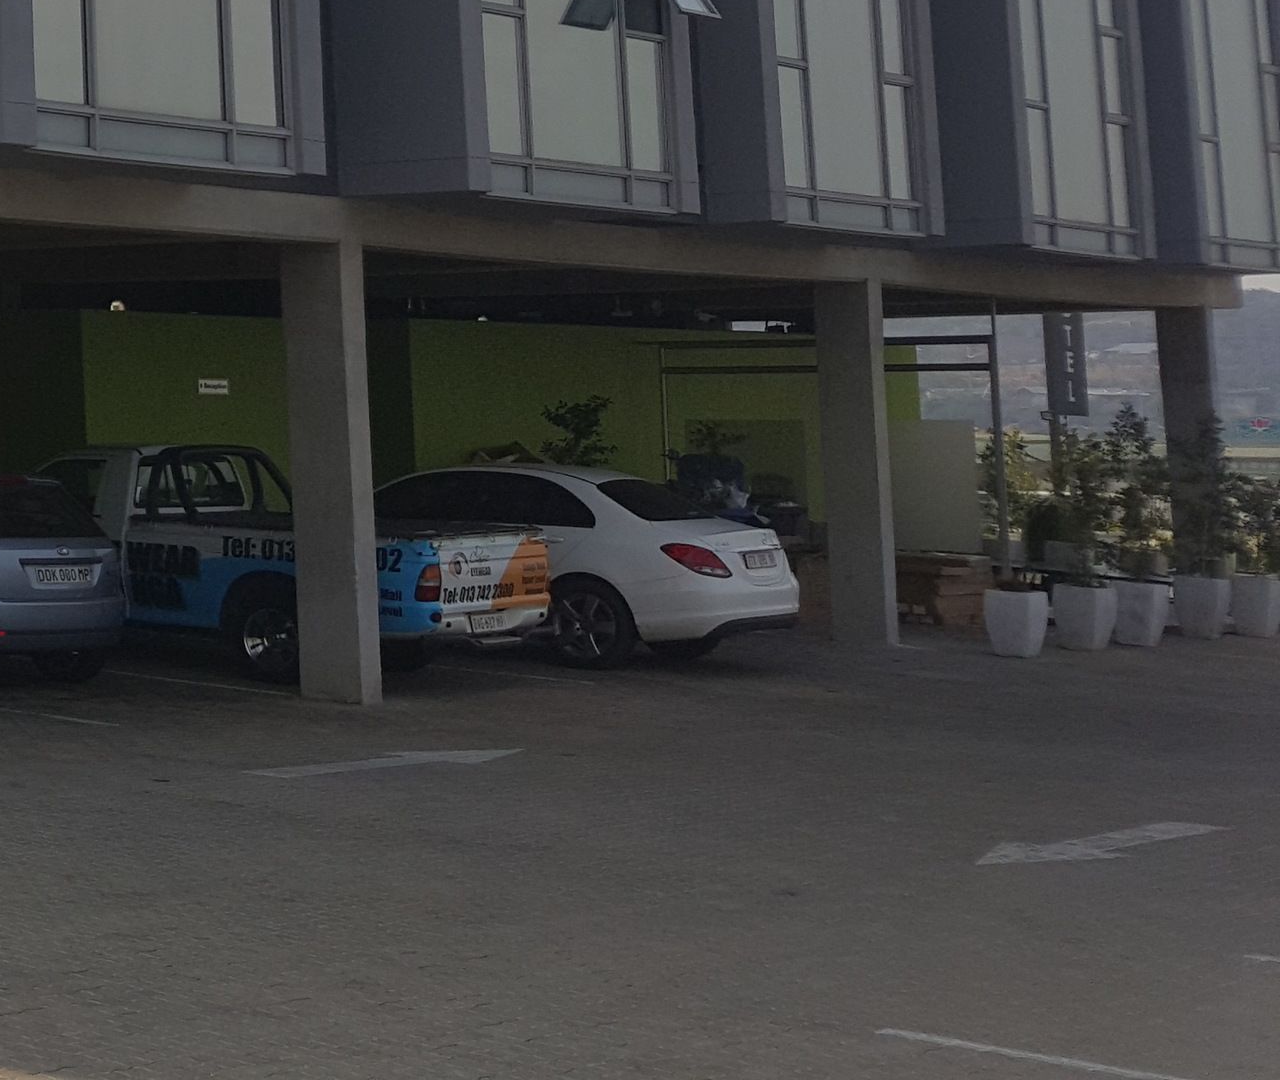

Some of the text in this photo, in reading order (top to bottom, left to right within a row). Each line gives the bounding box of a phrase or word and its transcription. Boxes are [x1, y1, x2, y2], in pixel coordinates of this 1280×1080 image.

[1061, 313, 1077, 403] TEL
[222, 535, 257, 560] Tel:
[443, 587, 458, 605] Tel:
[459, 585, 476, 603] 013
[476, 583, 492, 601] 742
